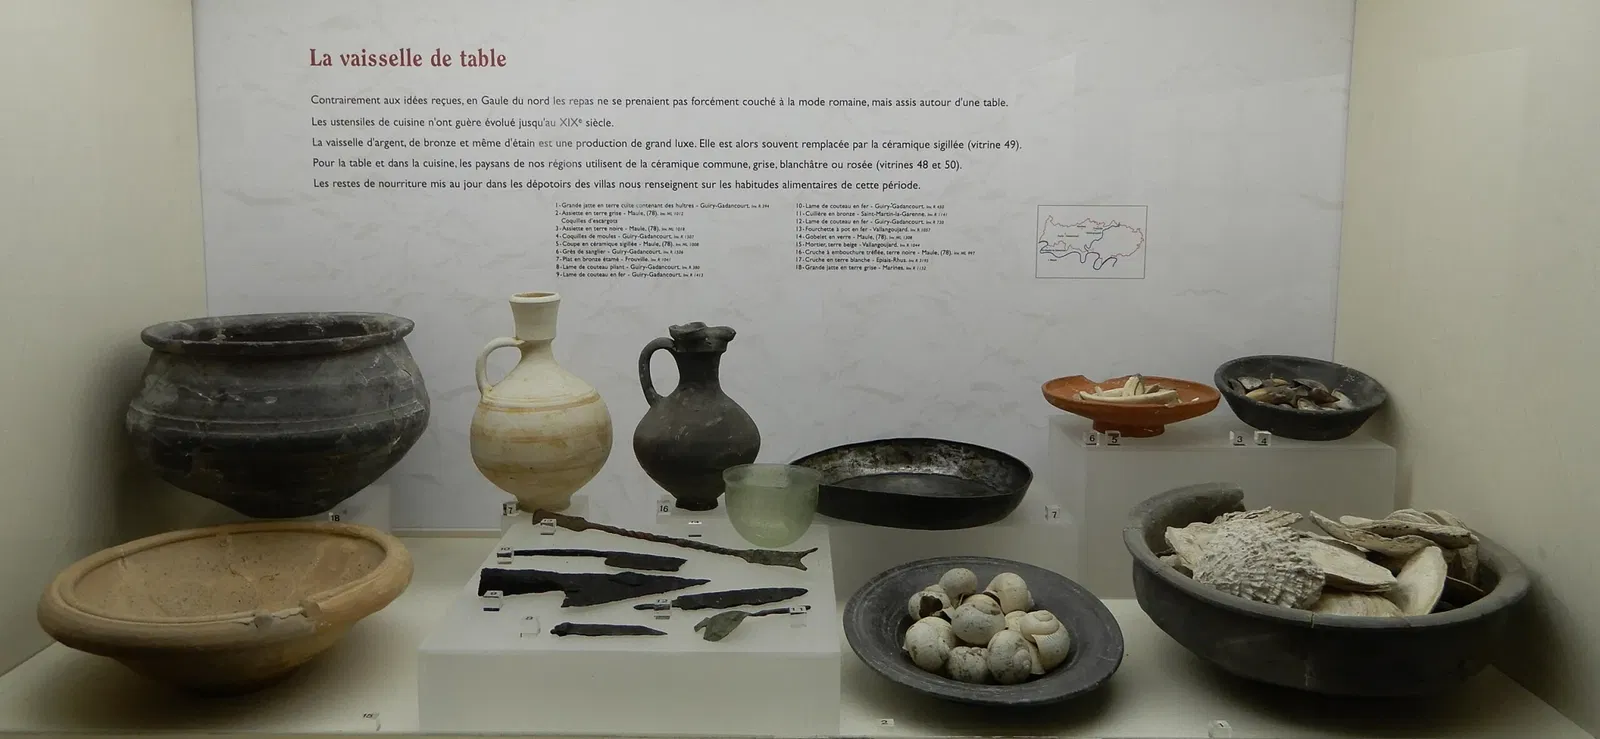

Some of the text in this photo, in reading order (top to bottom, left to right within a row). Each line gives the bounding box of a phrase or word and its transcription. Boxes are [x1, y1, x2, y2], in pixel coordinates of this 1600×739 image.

[310, 48, 506, 67] La vaisselle de table
[310, 95, 381, 105] Contrairement
[404, 96, 428, 105] idées
[431, 98, 464, 106] reçues,
[481, 96, 509, 105] Gaule
[512, 96, 524, 105] du
[527, 96, 550, 105] nord
[553, 96, 566, 105] les
[569, 98, 594, 108] repas
[625, 96, 670, 108] prenaient
[673, 99, 688, 108] pas
[691, 96, 739, 106] forcément
[742, 97, 776, 106] couché
[779, 97, 784, 106] à
[788, 97, 795, 106] la
[798, 97, 825, 106] mode
[828, 98, 870, 107] romaine,
[872, 98, 892, 106] mais
[896, 98, 917, 106] assis
[954, 97, 980, 107] d'une
[983, 98, 1008, 107] table.
[312, 117, 327, 126] Les
[330, 117, 375, 126] ustensiles
[378, 117, 390, 127] de
[393, 118, 425, 127] cuisine
[428, 117, 452, 127] n'ont
[455, 118, 482, 130] guère
[484, 118, 516, 127] évolué
[518, 118, 556, 130] jusqu'au
[586, 118, 614, 127] siècle.
[312, 137, 323, 146] La
[326, 138, 364, 147] vaisselle
[366, 138, 406, 149] d'argent,
[409, 138, 420, 147] de
[424, 138, 456, 147] bronze
[472, 138, 501, 147] même
[504, 138, 535, 147] d'étain
[576, 138, 627, 150] production
[630, 138, 642, 148] de
[645, 139, 672, 150] grand
[675, 139, 697, 148] luxe.
[700, 138, 716, 148] Elle
[736, 139, 758, 148] alors
[802, 139, 850, 151] remplacée
[852, 142, 868, 151] par
[871, 140, 879, 148] la
[882, 140, 930, 151] céramique
[933, 140, 964, 152] sigillée
[968, 140, 1001, 151] (vitrine
[1004, 140, 1022, 151] 49).
[313, 158, 335, 167] Pour
[338, 158, 346, 167] la
[349, 158, 372, 167] table
[388, 158, 409, 168] dans
[412, 158, 420, 167] la
[423, 159, 458, 168] cuisine,
[460, 158, 472, 168] les
[476, 161, 510, 170] paysans
[513, 159, 525, 168] de
[548, 159, 582, 170] régions
[586, 159, 622, 168] utilisent
[625, 159, 637, 168] de
[640, 159, 648, 168] la
[651, 159, 700, 171] céramique
[752, 160, 778, 171] grise,
[780, 160, 828, 169] blanchâtre
[847, 160, 873, 169] rosée
[876, 160, 914, 172] (vitrines
[916, 160, 928, 169] 48
[944, 160, 962, 172] 50).
[314, 179, 329, 188] Les
[364, 179, 375, 188] de
[378, 179, 427, 188] nourriture
[430, 180, 446, 188] mis
[464, 180, 483, 191] jour
[486, 179, 507, 188] dans
[510, 179, 523, 188] les
[526, 179, 572, 191] dépotoirs
[574, 179, 590, 188] des
[594, 179, 616, 188] villas
[645, 180, 698, 191] renseignent
[720, 180, 732, 189] les
[735, 180, 779, 189] habitudes
[782, 180, 838, 189] alimentaires
[841, 180, 852, 189] de
[882, 180, 920, 192] période.
